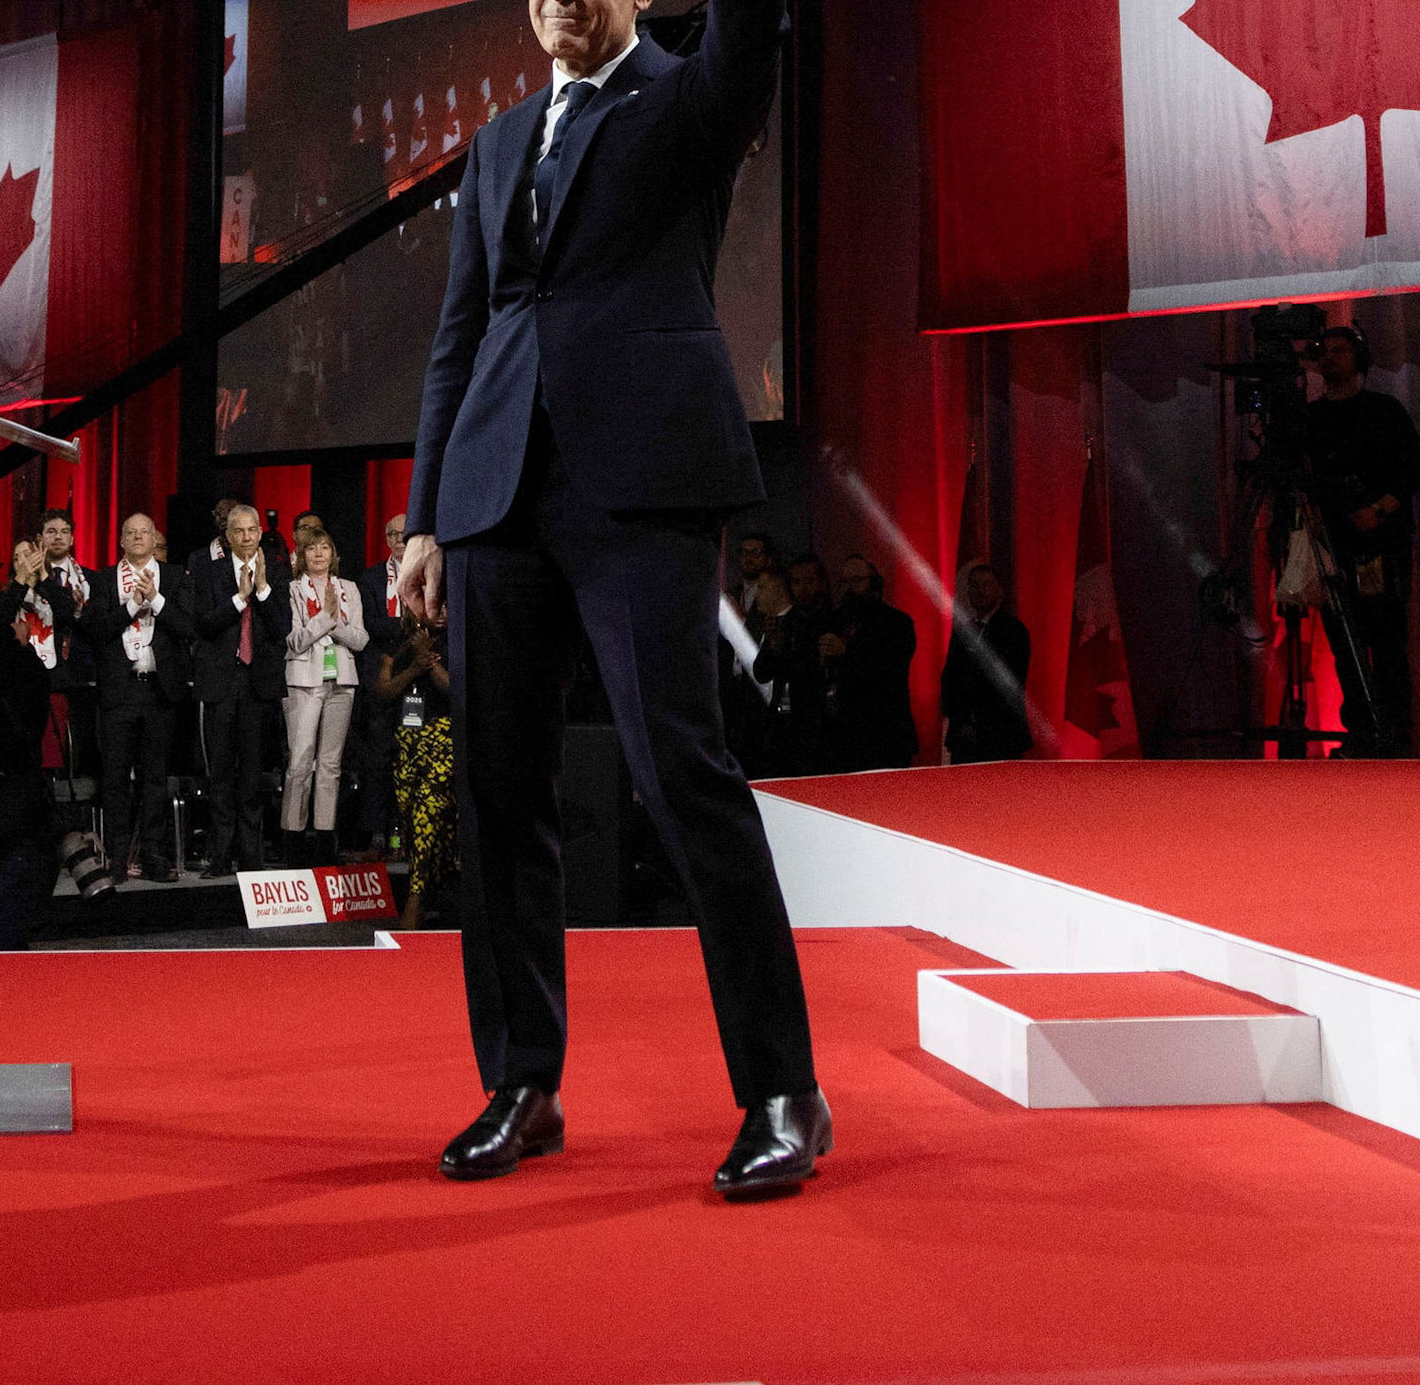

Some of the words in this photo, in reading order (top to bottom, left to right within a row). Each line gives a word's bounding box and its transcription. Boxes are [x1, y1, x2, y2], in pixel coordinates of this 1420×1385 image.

[251, 880, 309, 905] BAYLIS
[325, 871, 382, 900] BAYLIS
[332, 900, 344, 915] for
[345, 897, 377, 912] Canada
